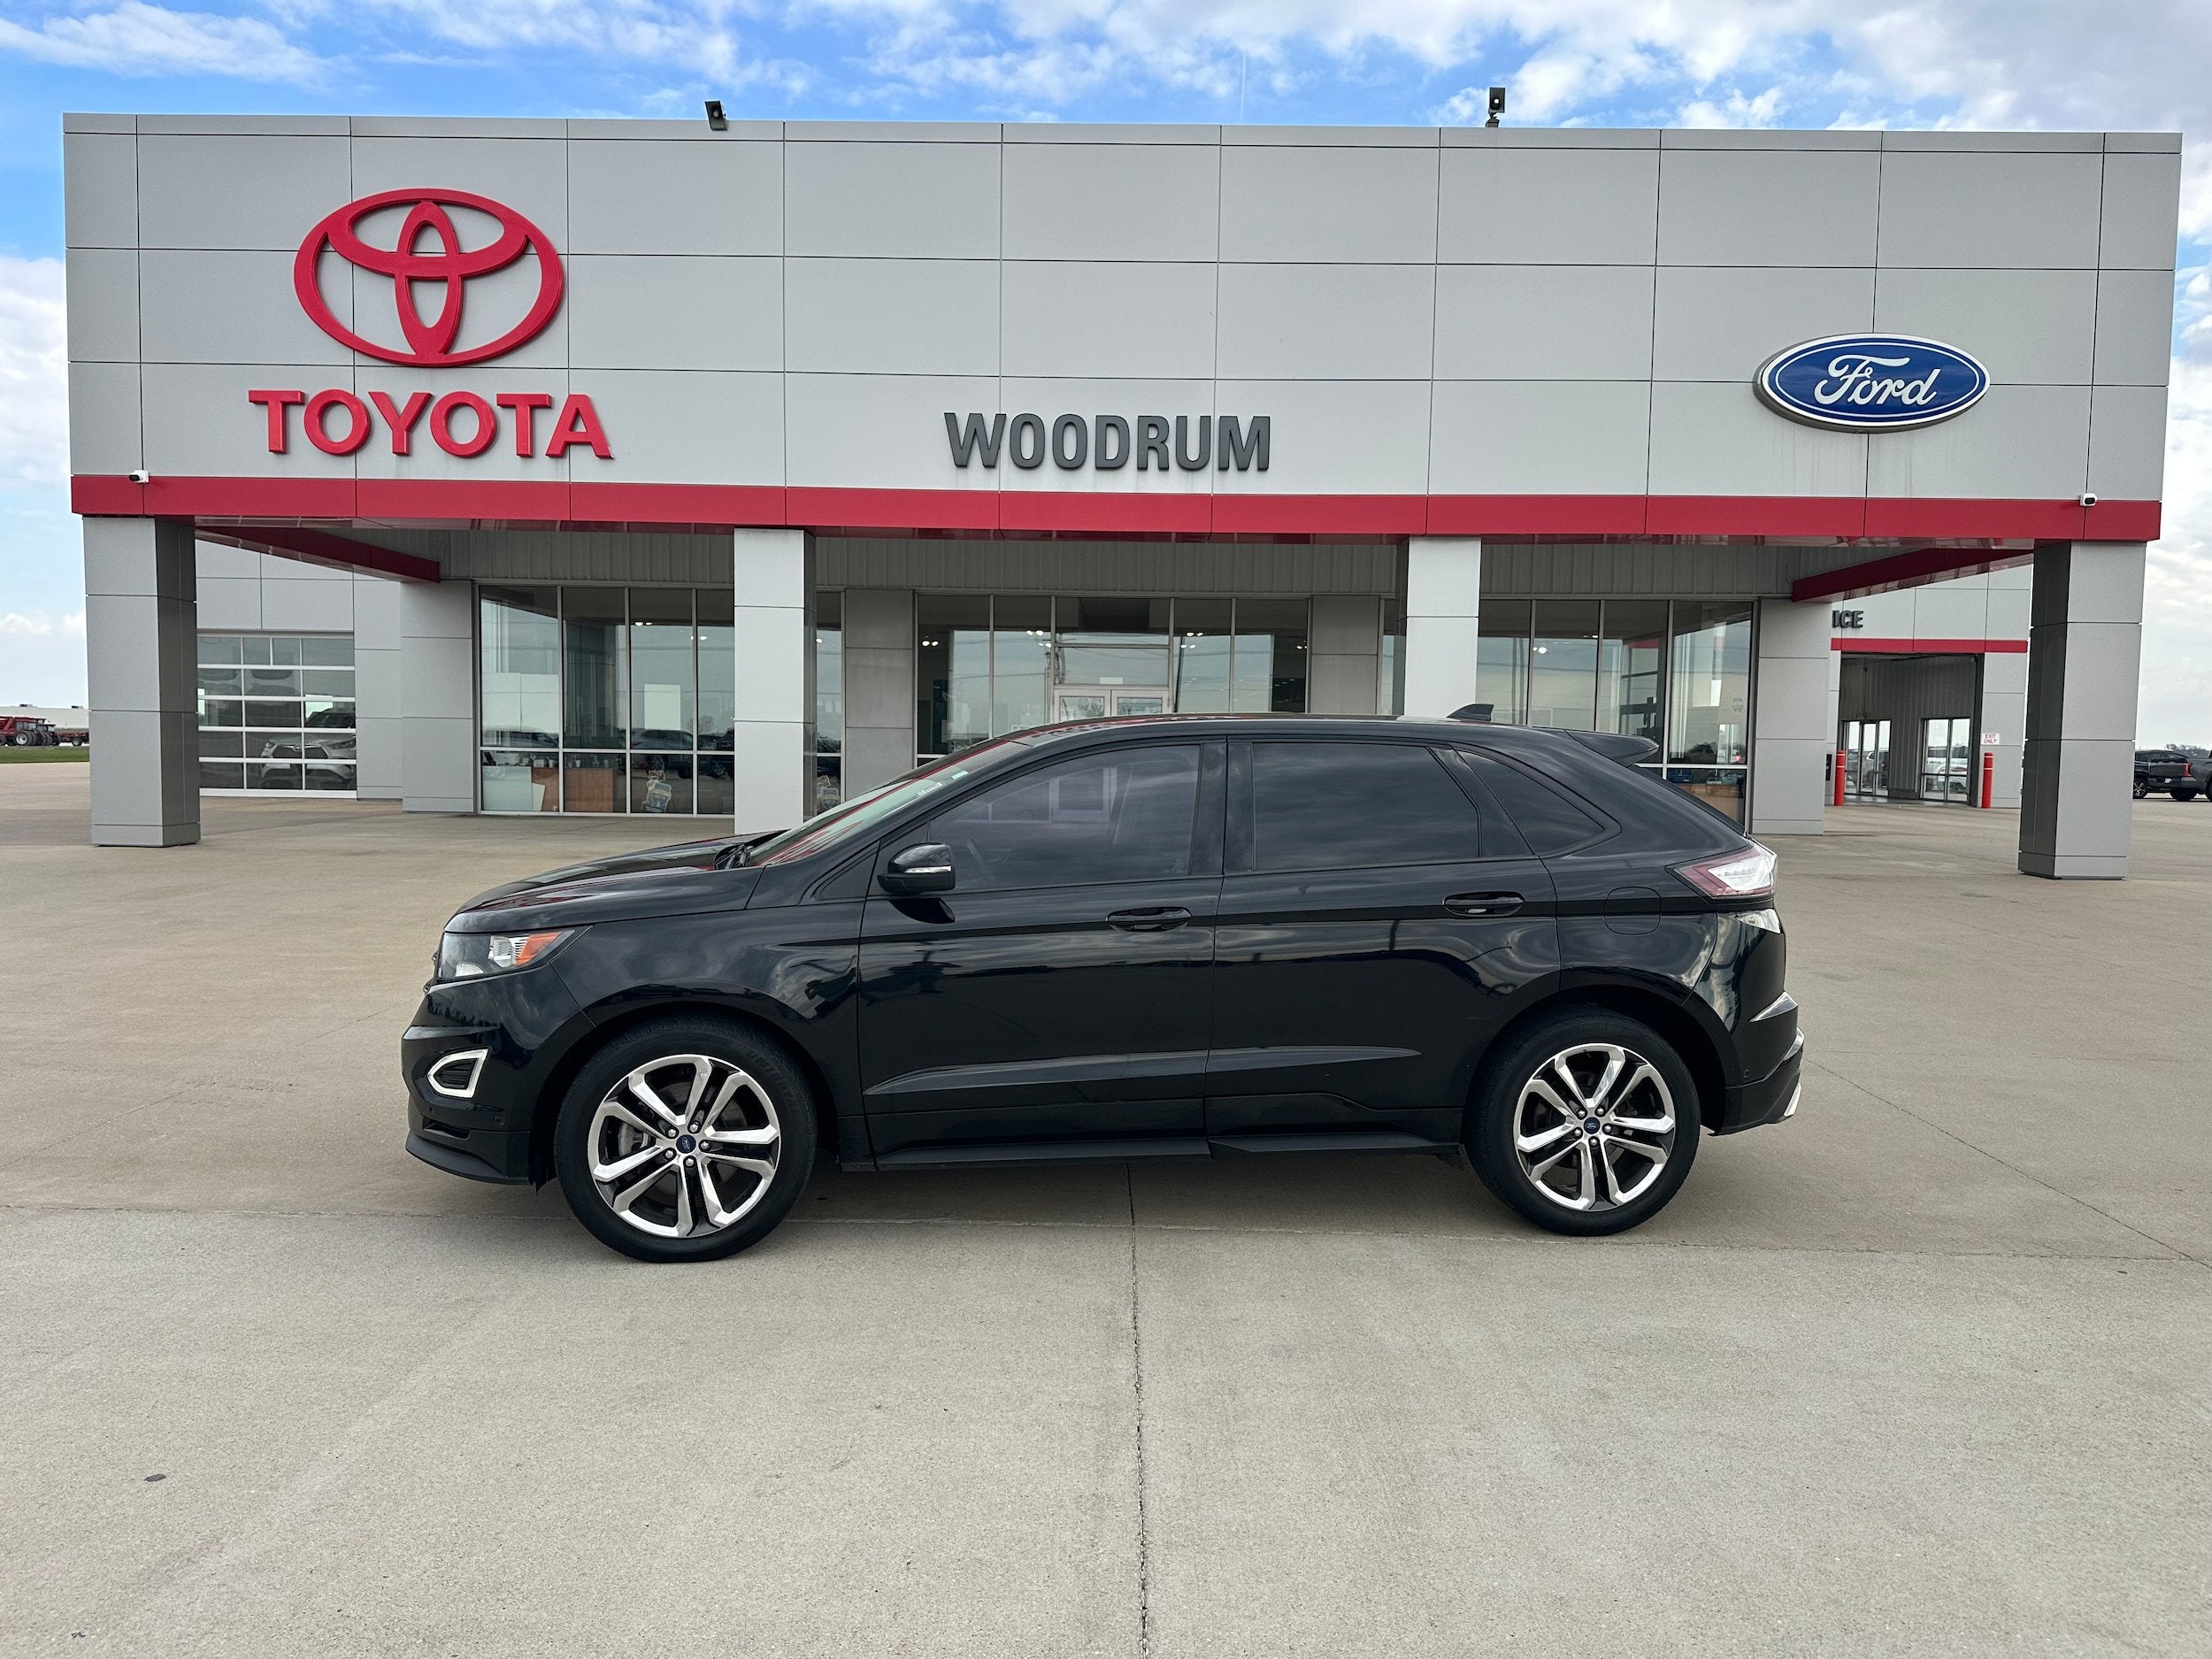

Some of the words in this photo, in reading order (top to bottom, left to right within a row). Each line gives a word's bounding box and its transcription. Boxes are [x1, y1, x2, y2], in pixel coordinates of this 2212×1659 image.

[1814, 354, 1941, 405] Ford
[248, 388, 615, 460] TOYOTA
[944, 412, 1271, 472] WOODRUM
